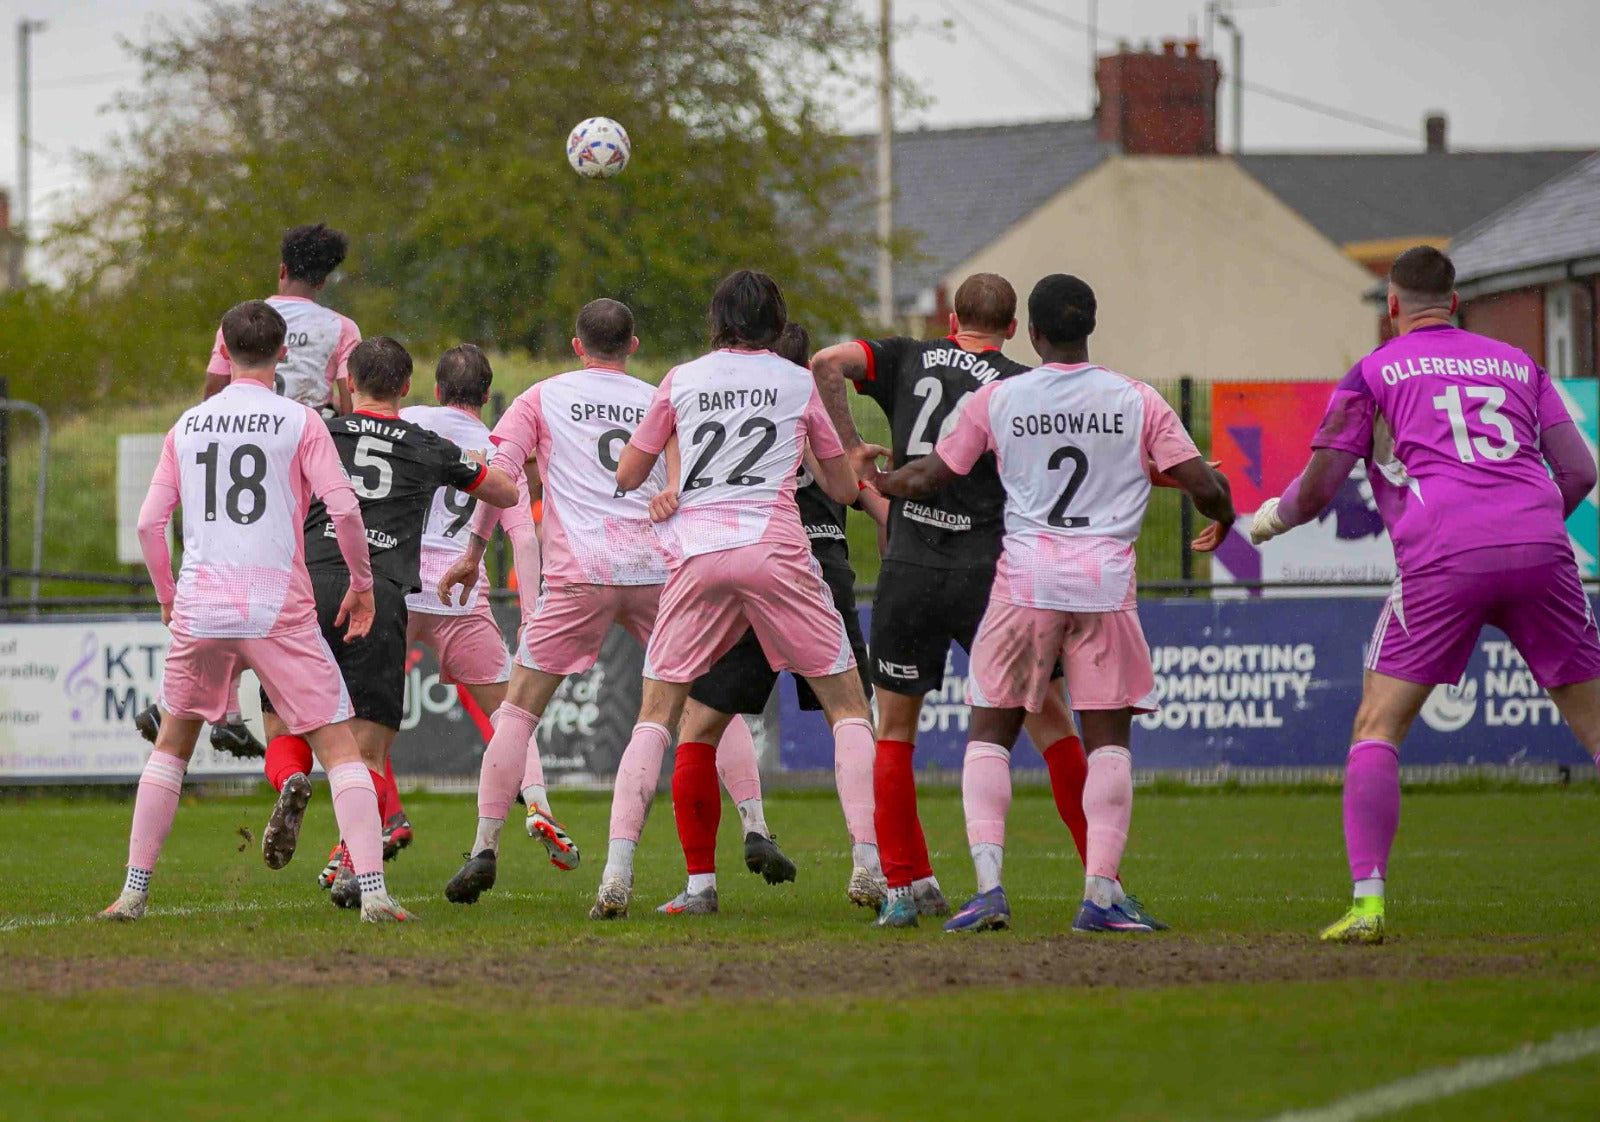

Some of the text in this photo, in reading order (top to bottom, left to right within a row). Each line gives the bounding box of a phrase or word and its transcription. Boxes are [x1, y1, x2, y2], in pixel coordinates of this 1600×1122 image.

[923, 348, 1000, 385] IBBITSON
[1381, 357, 1529, 386] OLLERENSHAW
[571, 403, 649, 424] SPENCE
[698, 388, 778, 412] BARTON
[185, 414, 286, 435] FLANNERY
[1012, 413, 1124, 437] SOBOWALE
[1433, 385, 1520, 463] 13
[351, 435, 393, 499] 5
[683, 416, 777, 492] 22
[196, 442, 268, 525] 18
[1047, 446, 1090, 528] 2
[903, 500, 972, 525] PHANTOM
[878, 659, 920, 680] NCS
[1152, 643, 1316, 673] UPPORTING
[1154, 672, 1312, 701] OMMUNITY
[1137, 701, 1283, 730] OOTBALL
